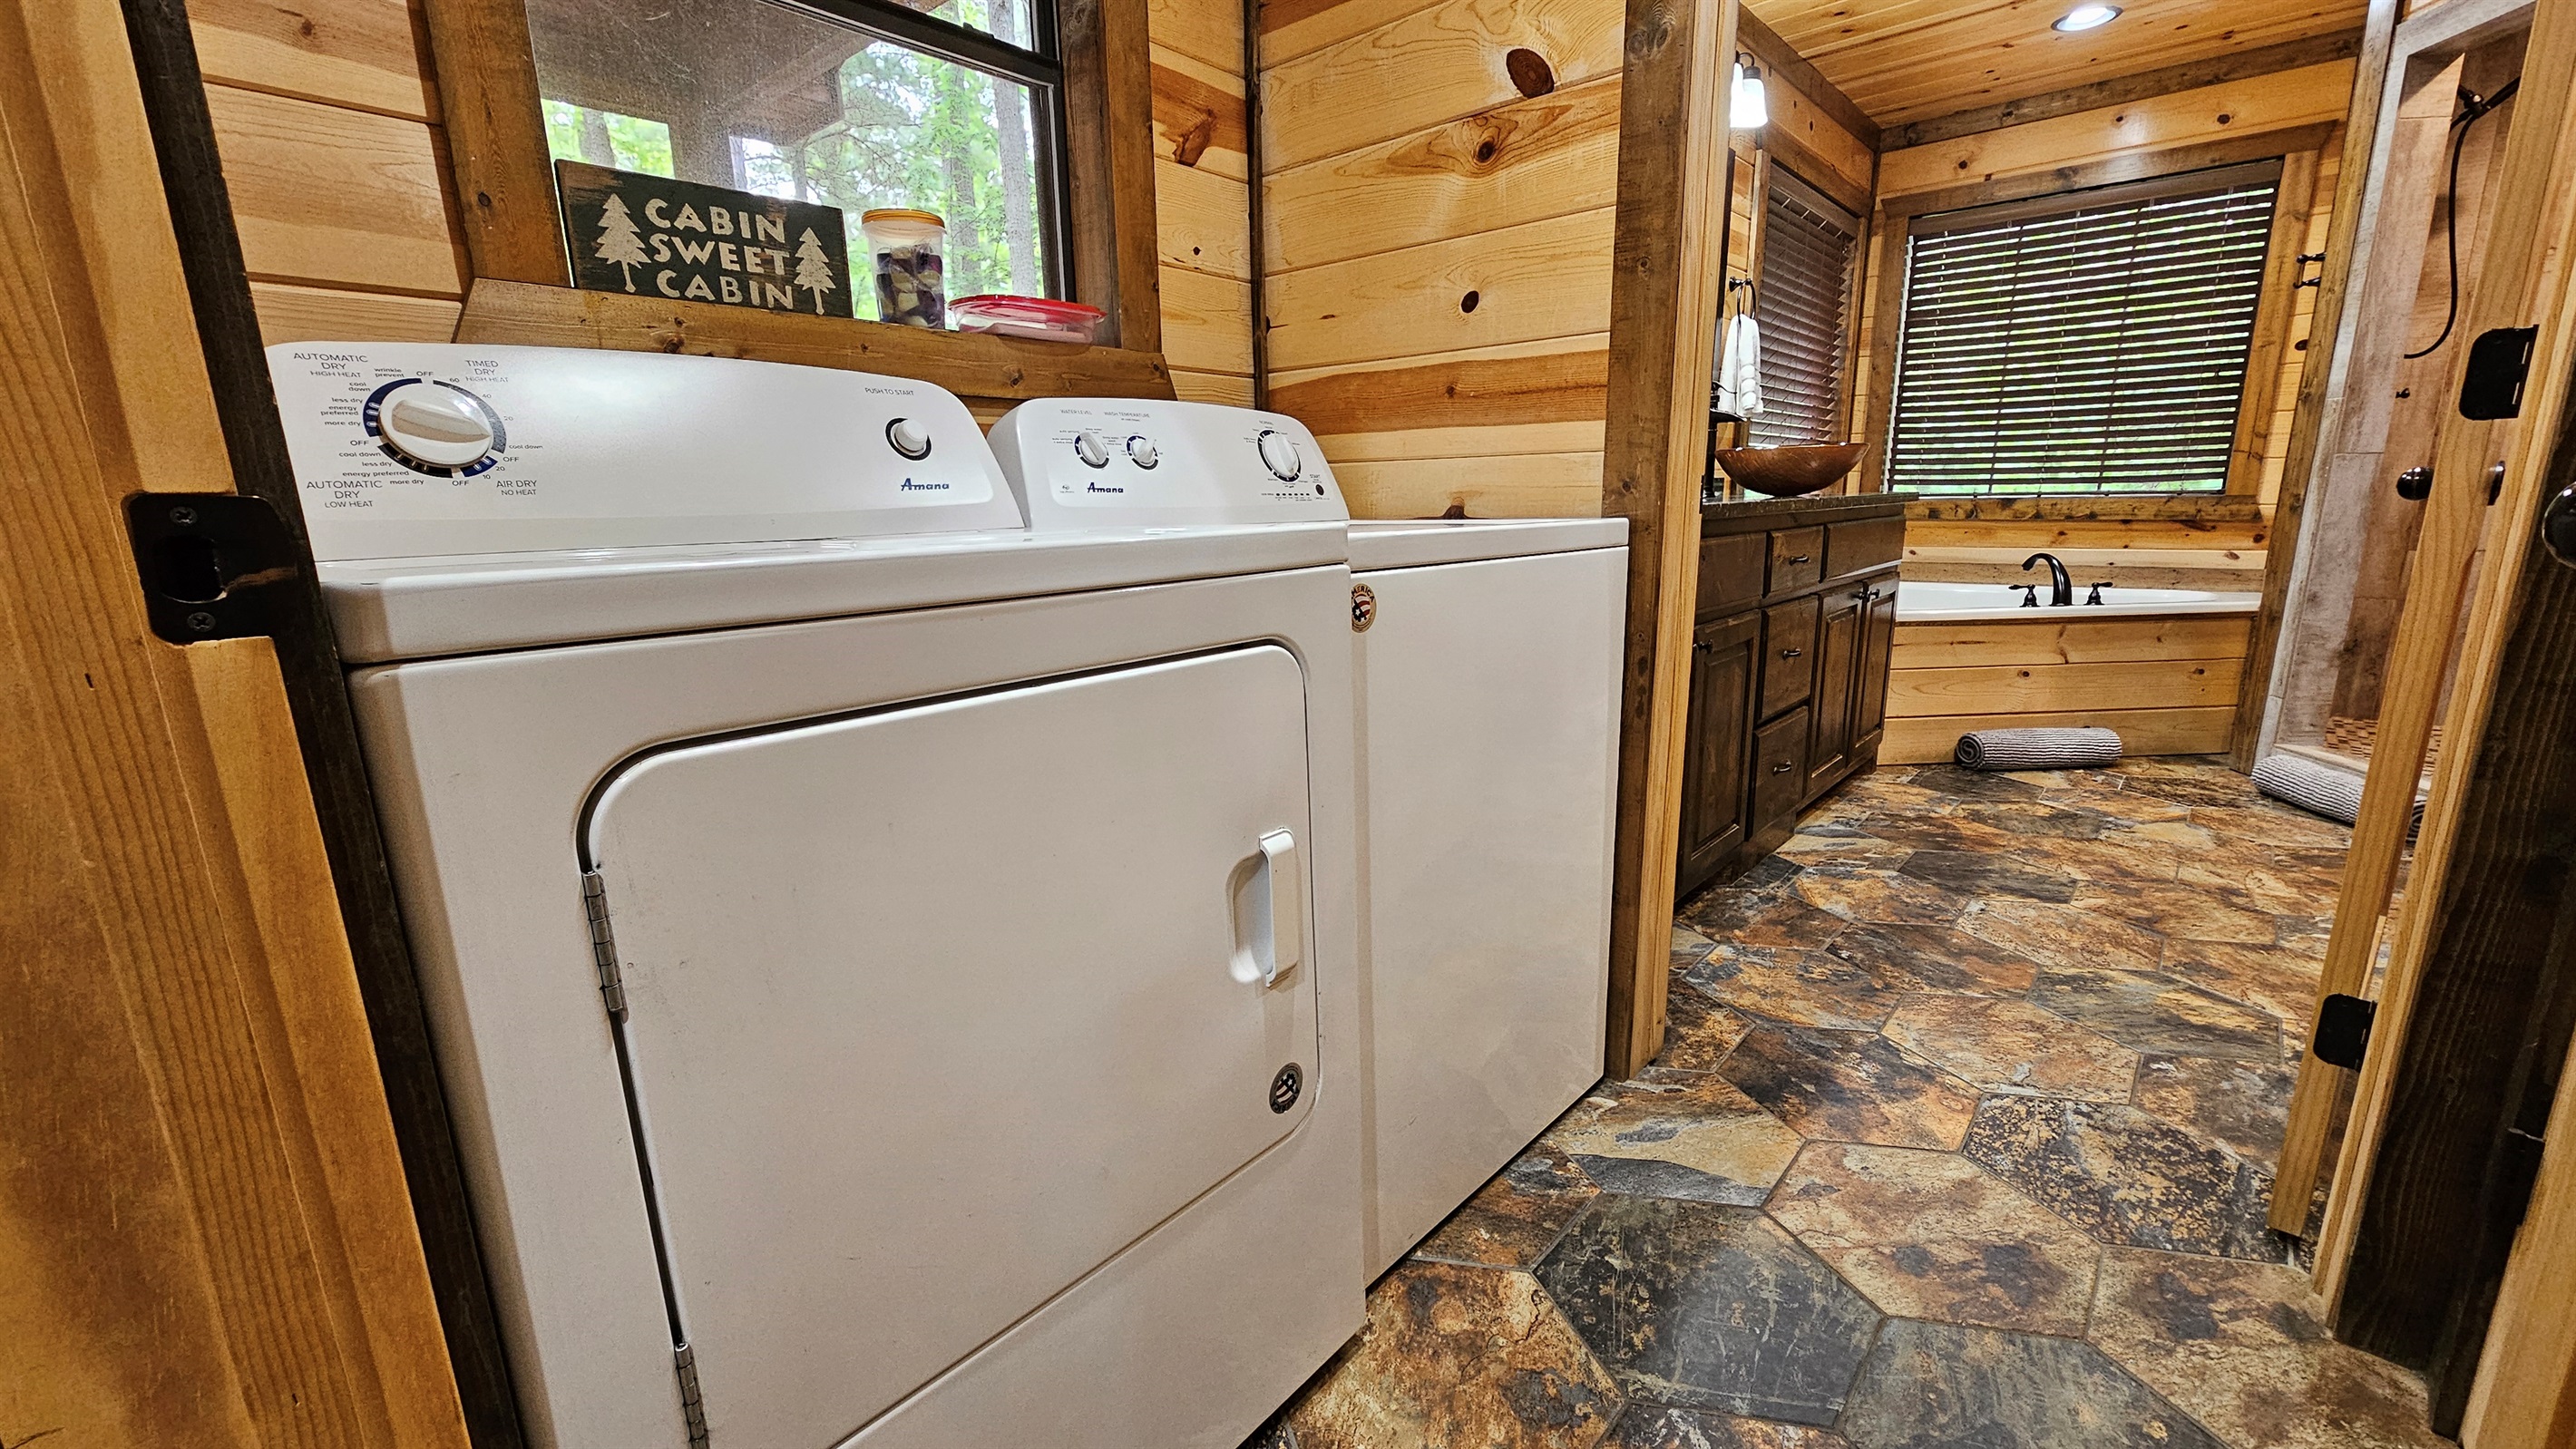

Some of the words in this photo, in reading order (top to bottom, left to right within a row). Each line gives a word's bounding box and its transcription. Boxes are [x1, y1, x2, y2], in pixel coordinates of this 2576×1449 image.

[644, 198, 785, 243] CABIN
[649, 233, 790, 276] SWEET
[656, 269, 794, 309] CABIN
[293, 353, 368, 363] AUTOMATIC
[321, 362, 346, 370] DRY
[464, 360, 499, 368] TIMED
[307, 480, 383, 489] AUTOMATIC
[496, 480, 513, 488] AIR
[515, 480, 537, 488] DRY
[900, 477, 950, 491] Amana
[1087, 481, 1124, 493] Amana
[334, 491, 360, 499] DRY
[324, 501, 346, 509] LOW
[348, 500, 374, 508] HEAT
[1351, 585, 1375, 603] MERICA
